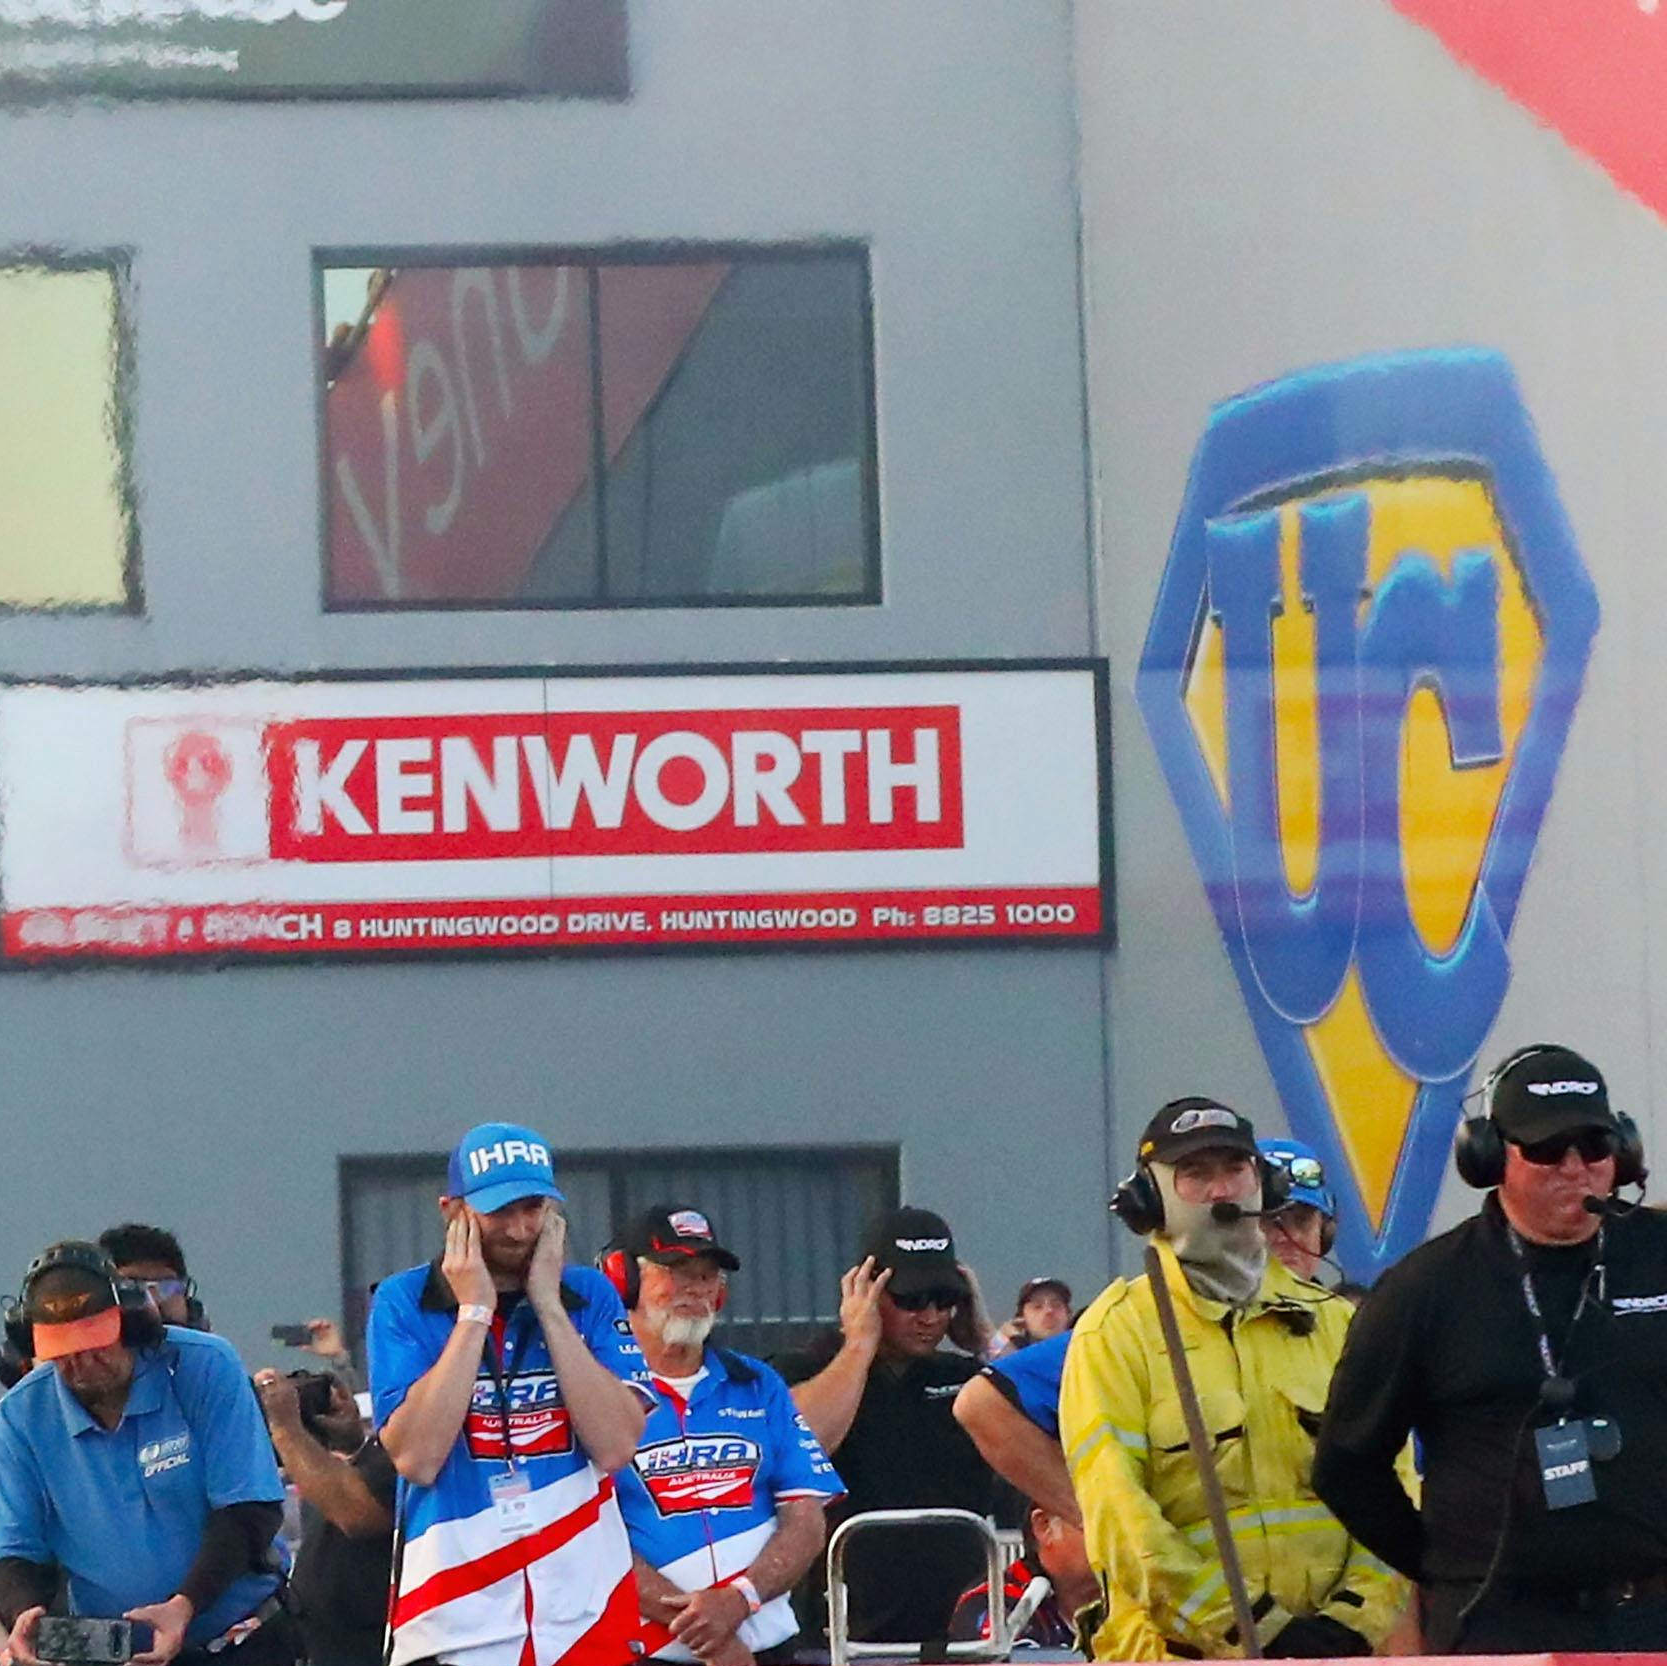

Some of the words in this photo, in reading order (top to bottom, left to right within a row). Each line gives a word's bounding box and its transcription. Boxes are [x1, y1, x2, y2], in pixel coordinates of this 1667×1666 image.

[293, 728, 941, 836] KENWORTH
[333, 919, 352, 939] 8
[359, 913, 560, 939] HUNTINGWOOD
[660, 907, 858, 931] HUNTINGWOOD
[872, 907, 916, 928] Ph:
[923, 904, 996, 927] 8825
[1005, 902, 1076, 925] 1000
[468, 1140, 551, 1176] IHRA
[668, 1470, 737, 1487] AUSTRALIA
[1543, 1460, 1589, 1481] STAFF
